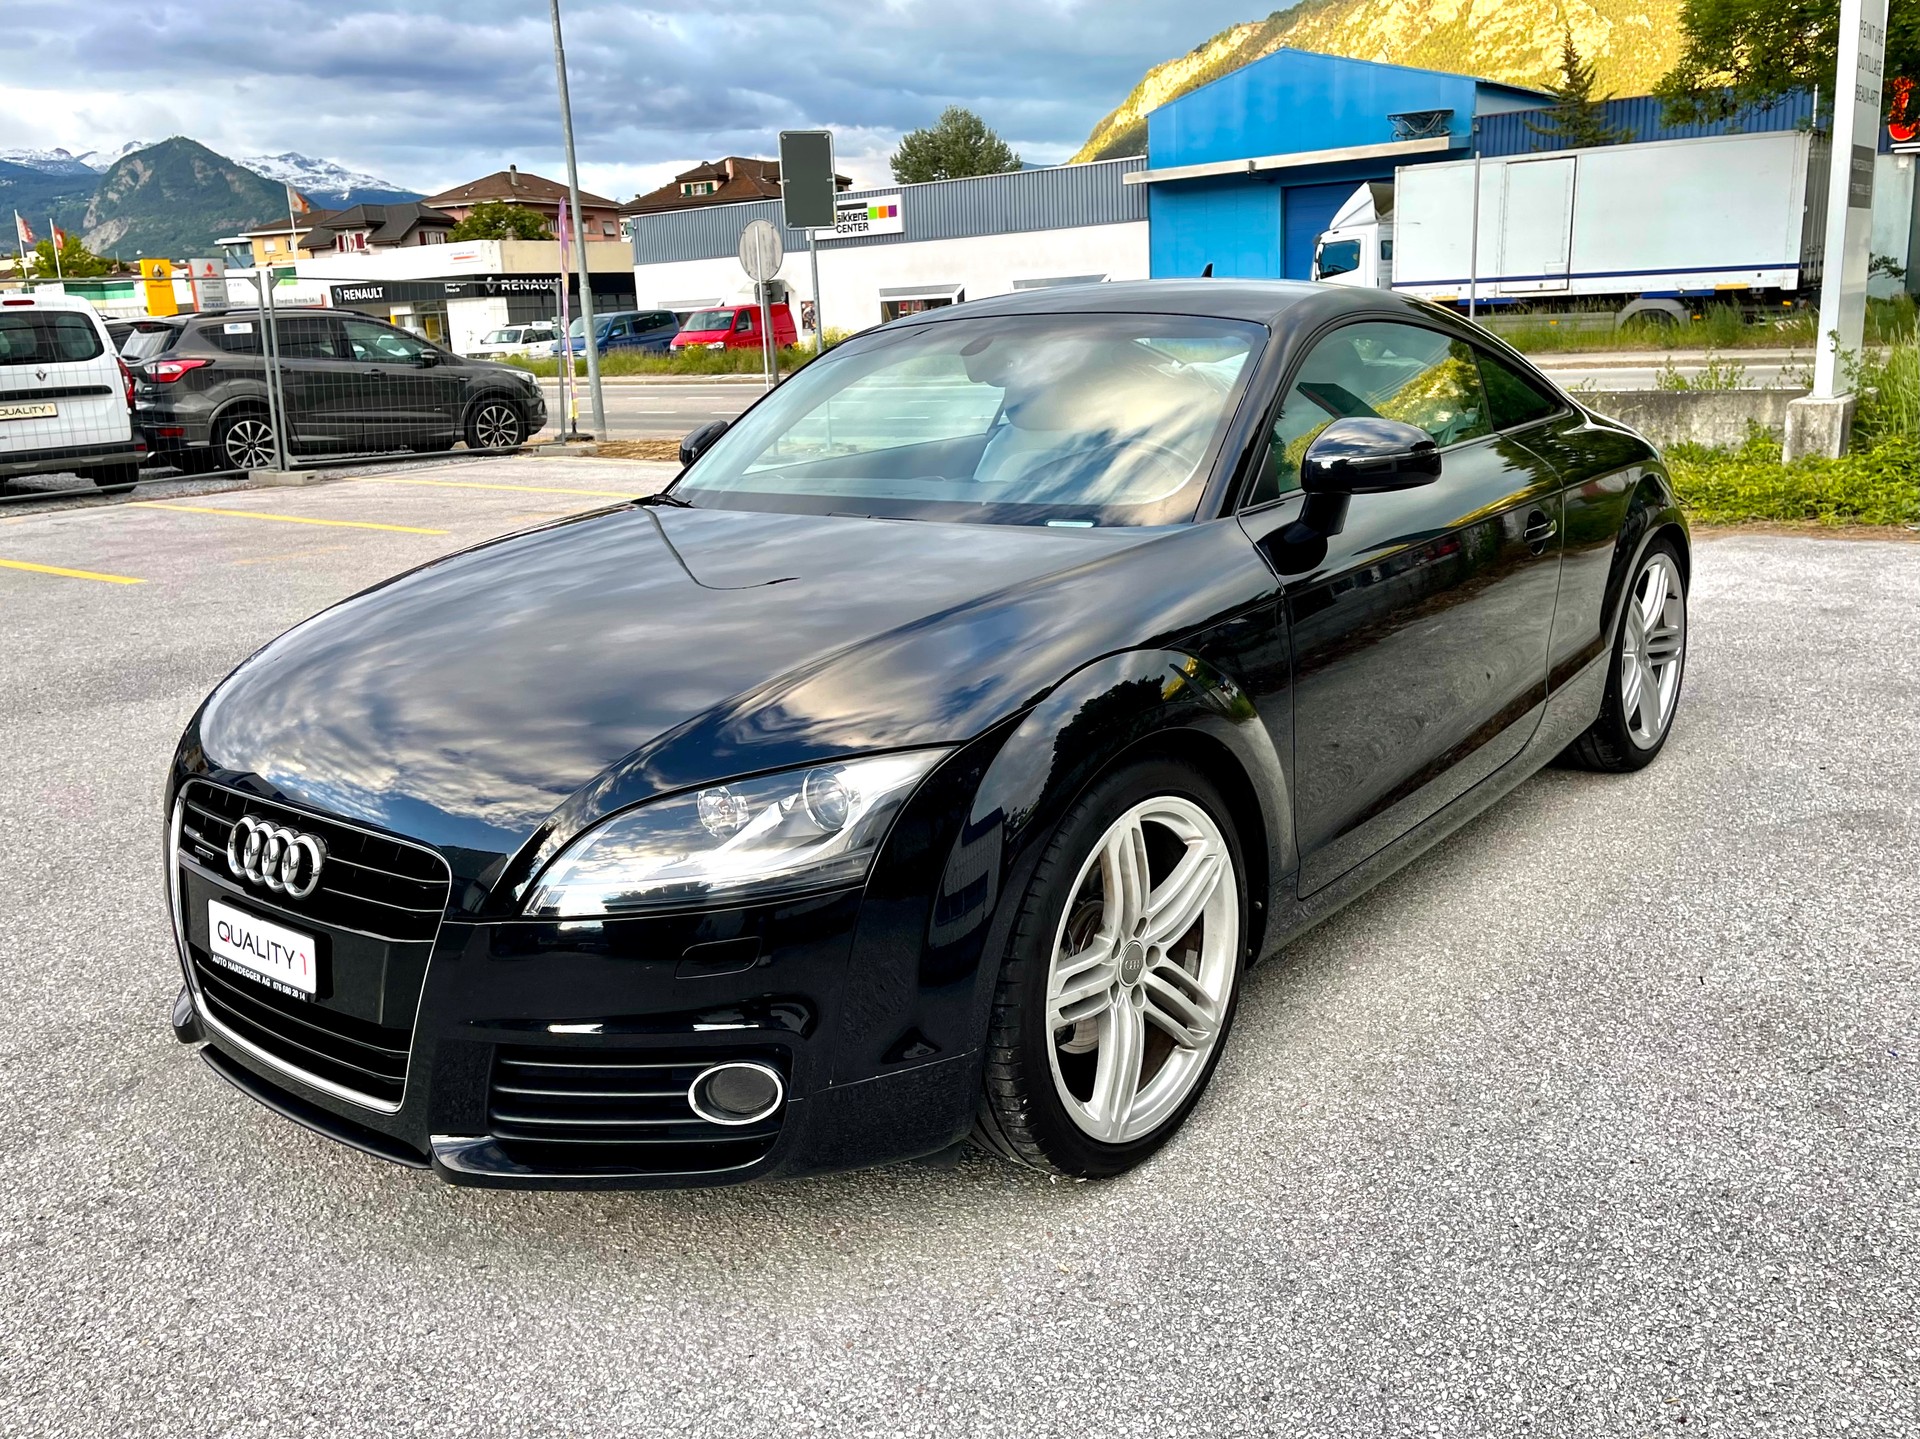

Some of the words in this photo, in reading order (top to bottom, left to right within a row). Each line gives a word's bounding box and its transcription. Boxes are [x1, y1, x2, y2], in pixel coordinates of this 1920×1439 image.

[1860, 19, 1885, 46] PEINTURE
[1858, 51, 1882, 78] OUTILLAGE
[836, 222, 869, 233] CENTER
[343, 286, 383, 301] RENAULT
[500, 279, 562, 291] RENAU
[217, 920, 295, 970] QUALITY
[212, 954, 227, 968] AUTO
[227, 960, 261, 983] HARDEGGER
[261, 975, 271, 987] AG
[292, 988, 299, 998] 20
[299, 991, 306, 1001] 14
